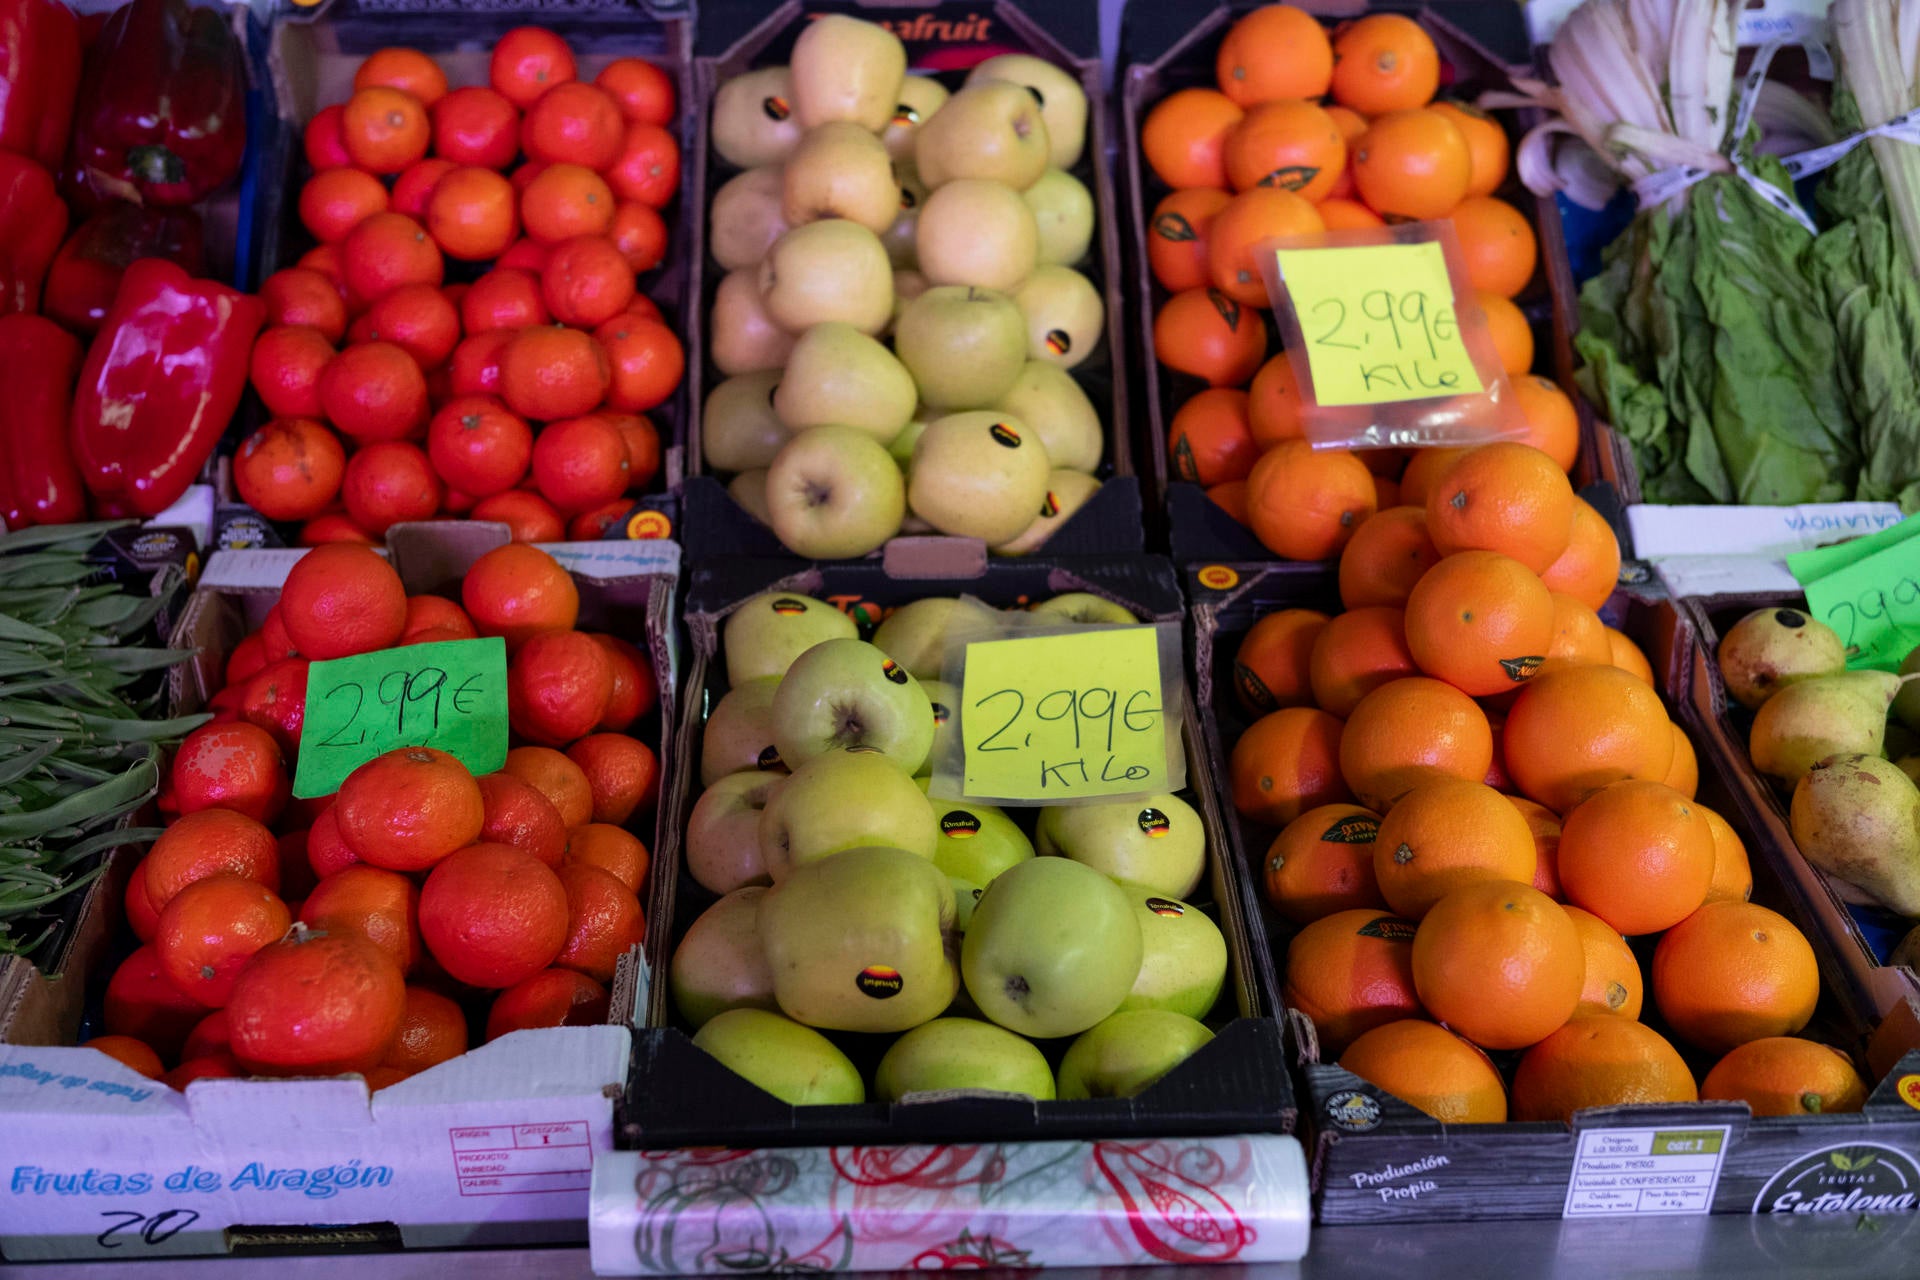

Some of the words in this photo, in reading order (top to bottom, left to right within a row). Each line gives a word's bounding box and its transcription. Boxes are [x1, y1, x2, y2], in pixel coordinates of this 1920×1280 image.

[1041, 755, 1150, 788] KILO
[11, 1165, 154, 1195] Frutas
[164, 1166, 222, 1193] de
[229, 1160, 394, 1198] Aragón
[1350, 1155, 1450, 1188] Producción
[1818, 1173, 1877, 1185] FRUTAS
[1376, 1180, 1438, 1203] Propia
[98, 1209, 200, 1248] 20
